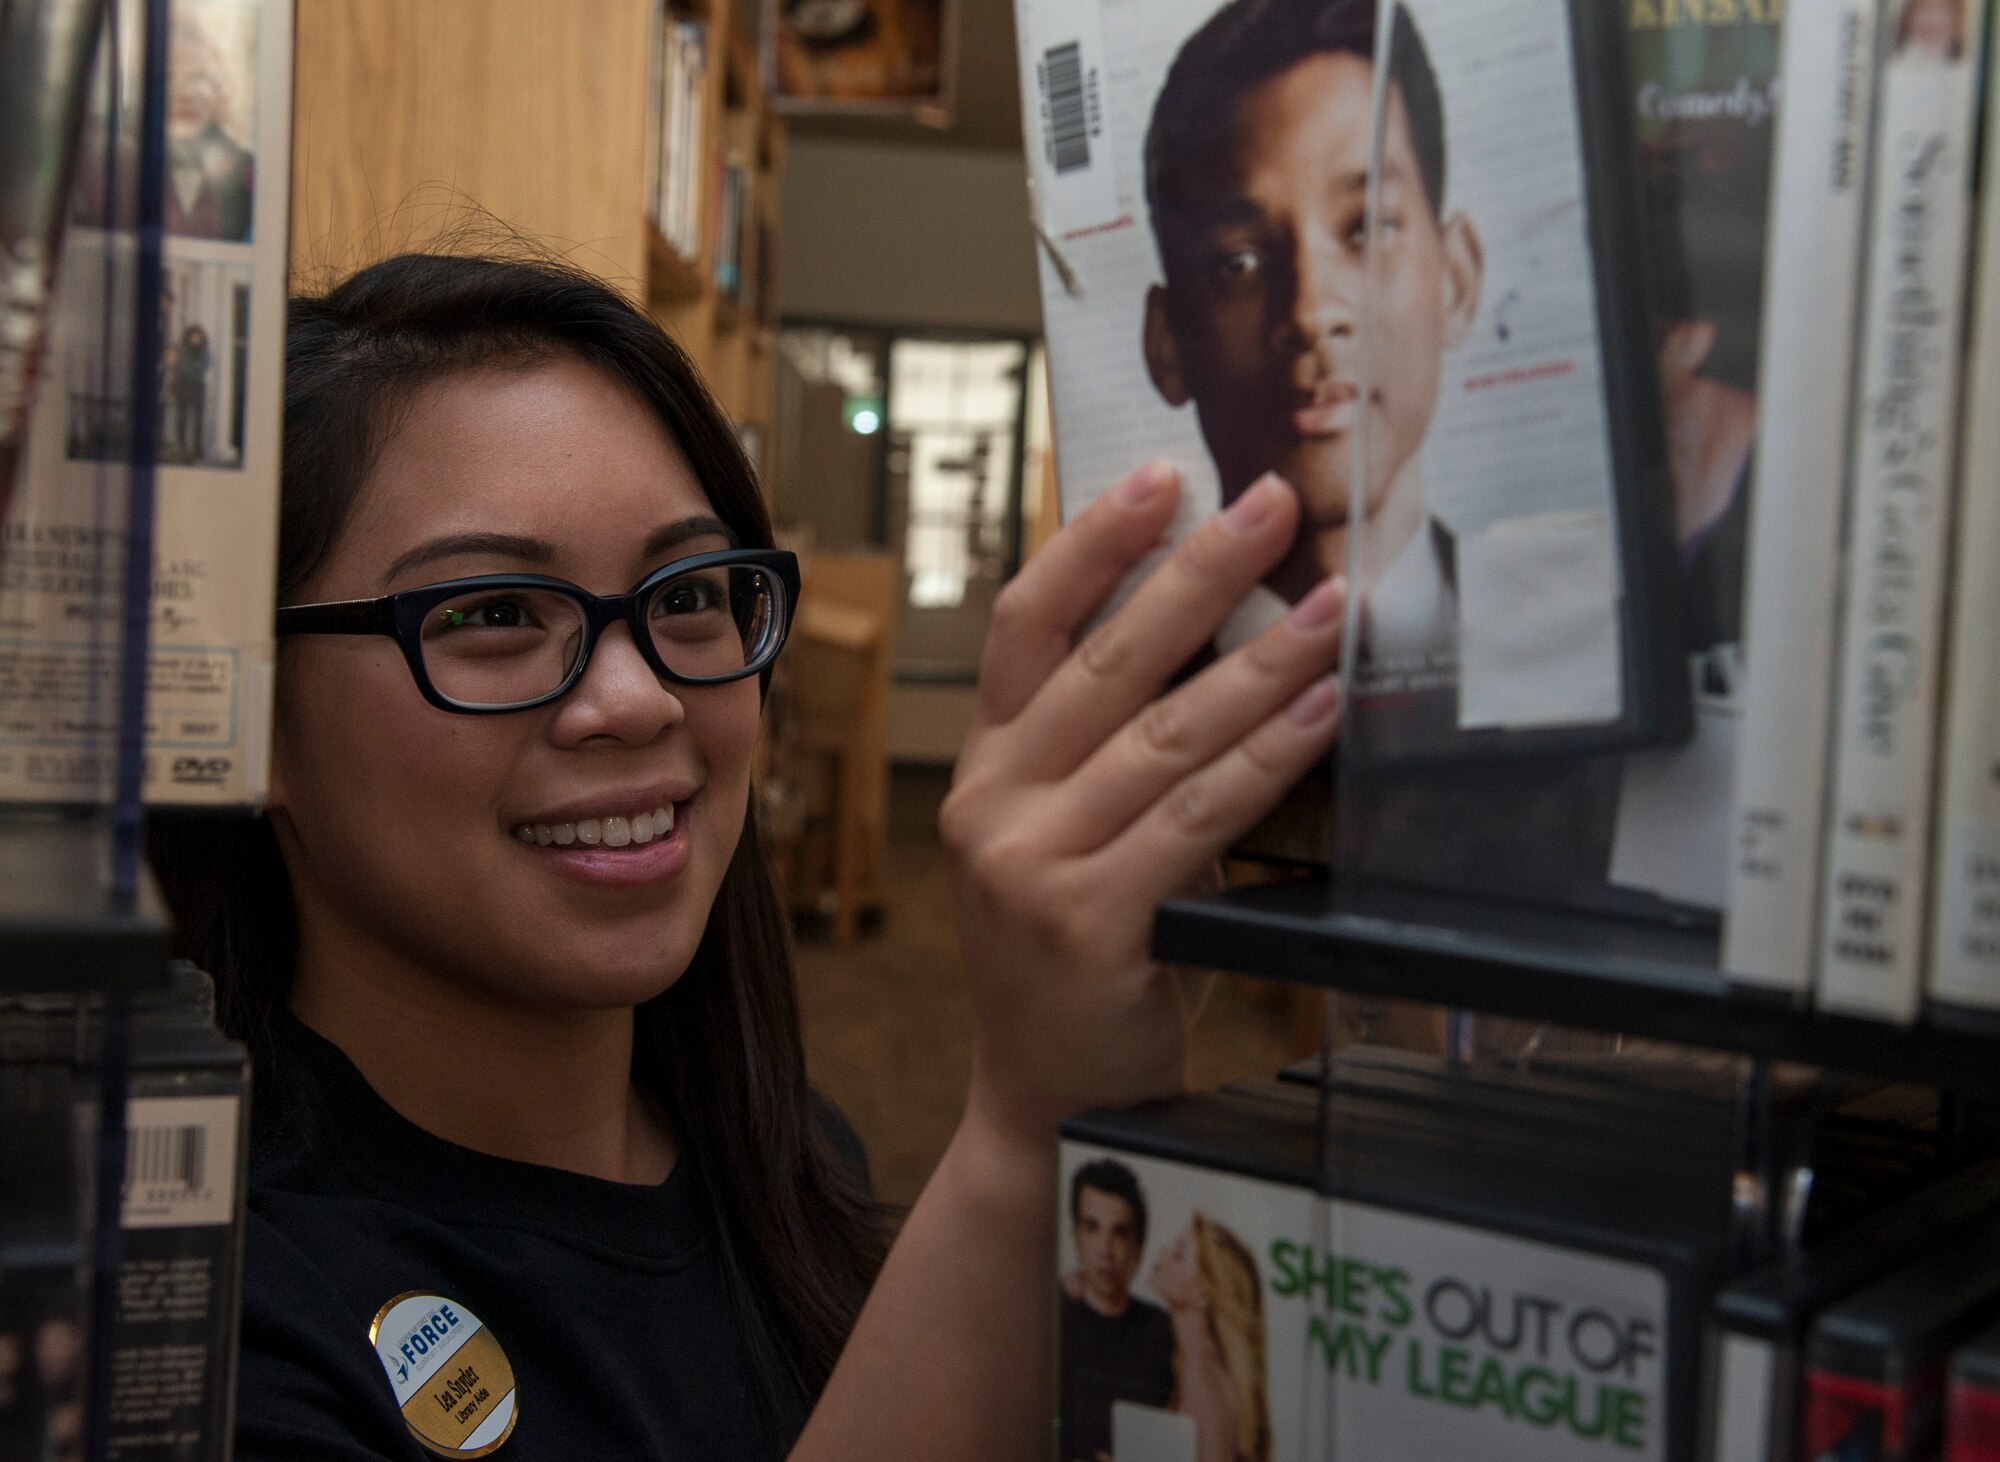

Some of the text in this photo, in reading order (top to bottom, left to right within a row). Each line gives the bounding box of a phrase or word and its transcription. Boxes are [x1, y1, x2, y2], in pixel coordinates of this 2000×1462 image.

[400, 1304, 459, 1365] FORCE
[1268, 1237, 1656, 1378] SHE'S OUT OF
[433, 1365, 479, 1413] Lea Snyder
[455, 1388, 490, 1424] Library Aide
[1307, 1315, 1647, 1451] MY LEAGUE
